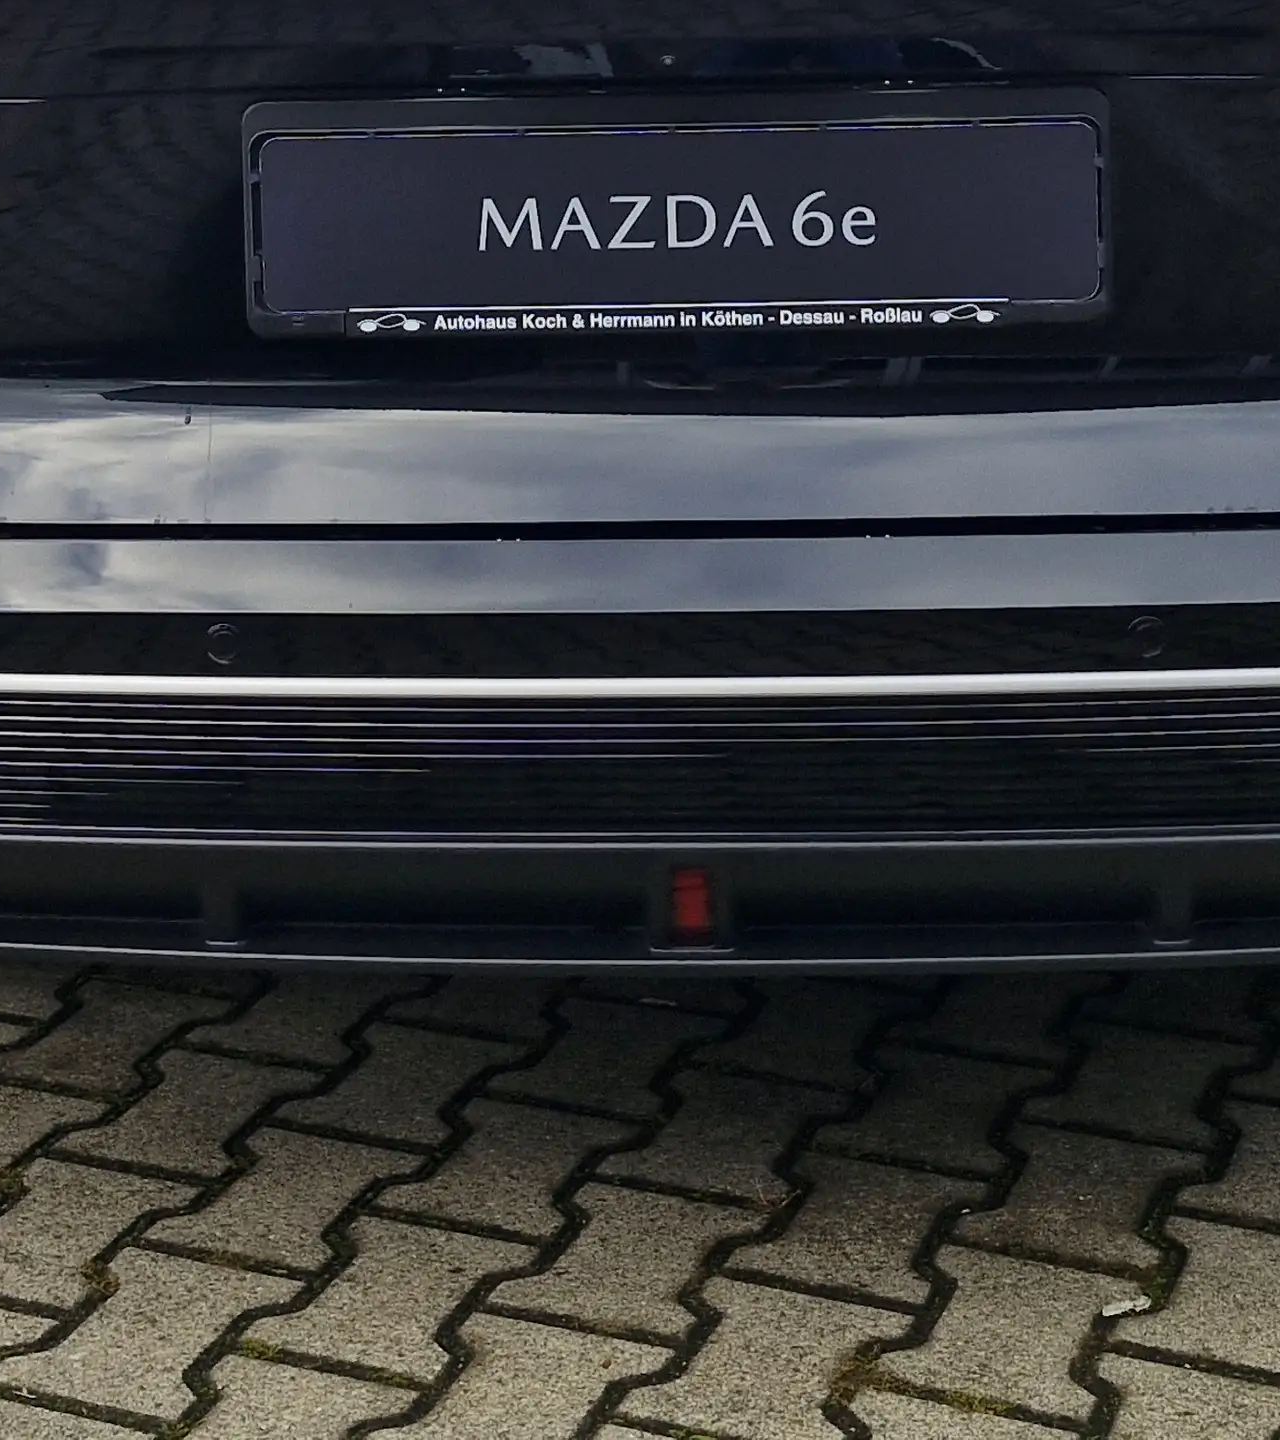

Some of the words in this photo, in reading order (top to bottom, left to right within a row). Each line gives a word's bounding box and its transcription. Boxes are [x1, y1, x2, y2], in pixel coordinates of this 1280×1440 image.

[433, 313, 518, 332] Autohaus
[522, 312, 568, 331] Koch
[571, 313, 585, 329] &
[589, 311, 676, 329] Herrmann
[680, 311, 697, 328] in
[701, 309, 764, 328] Köthen
[779, 309, 845, 326] Dessau
[860, 306, 923, 325] Roßlau
